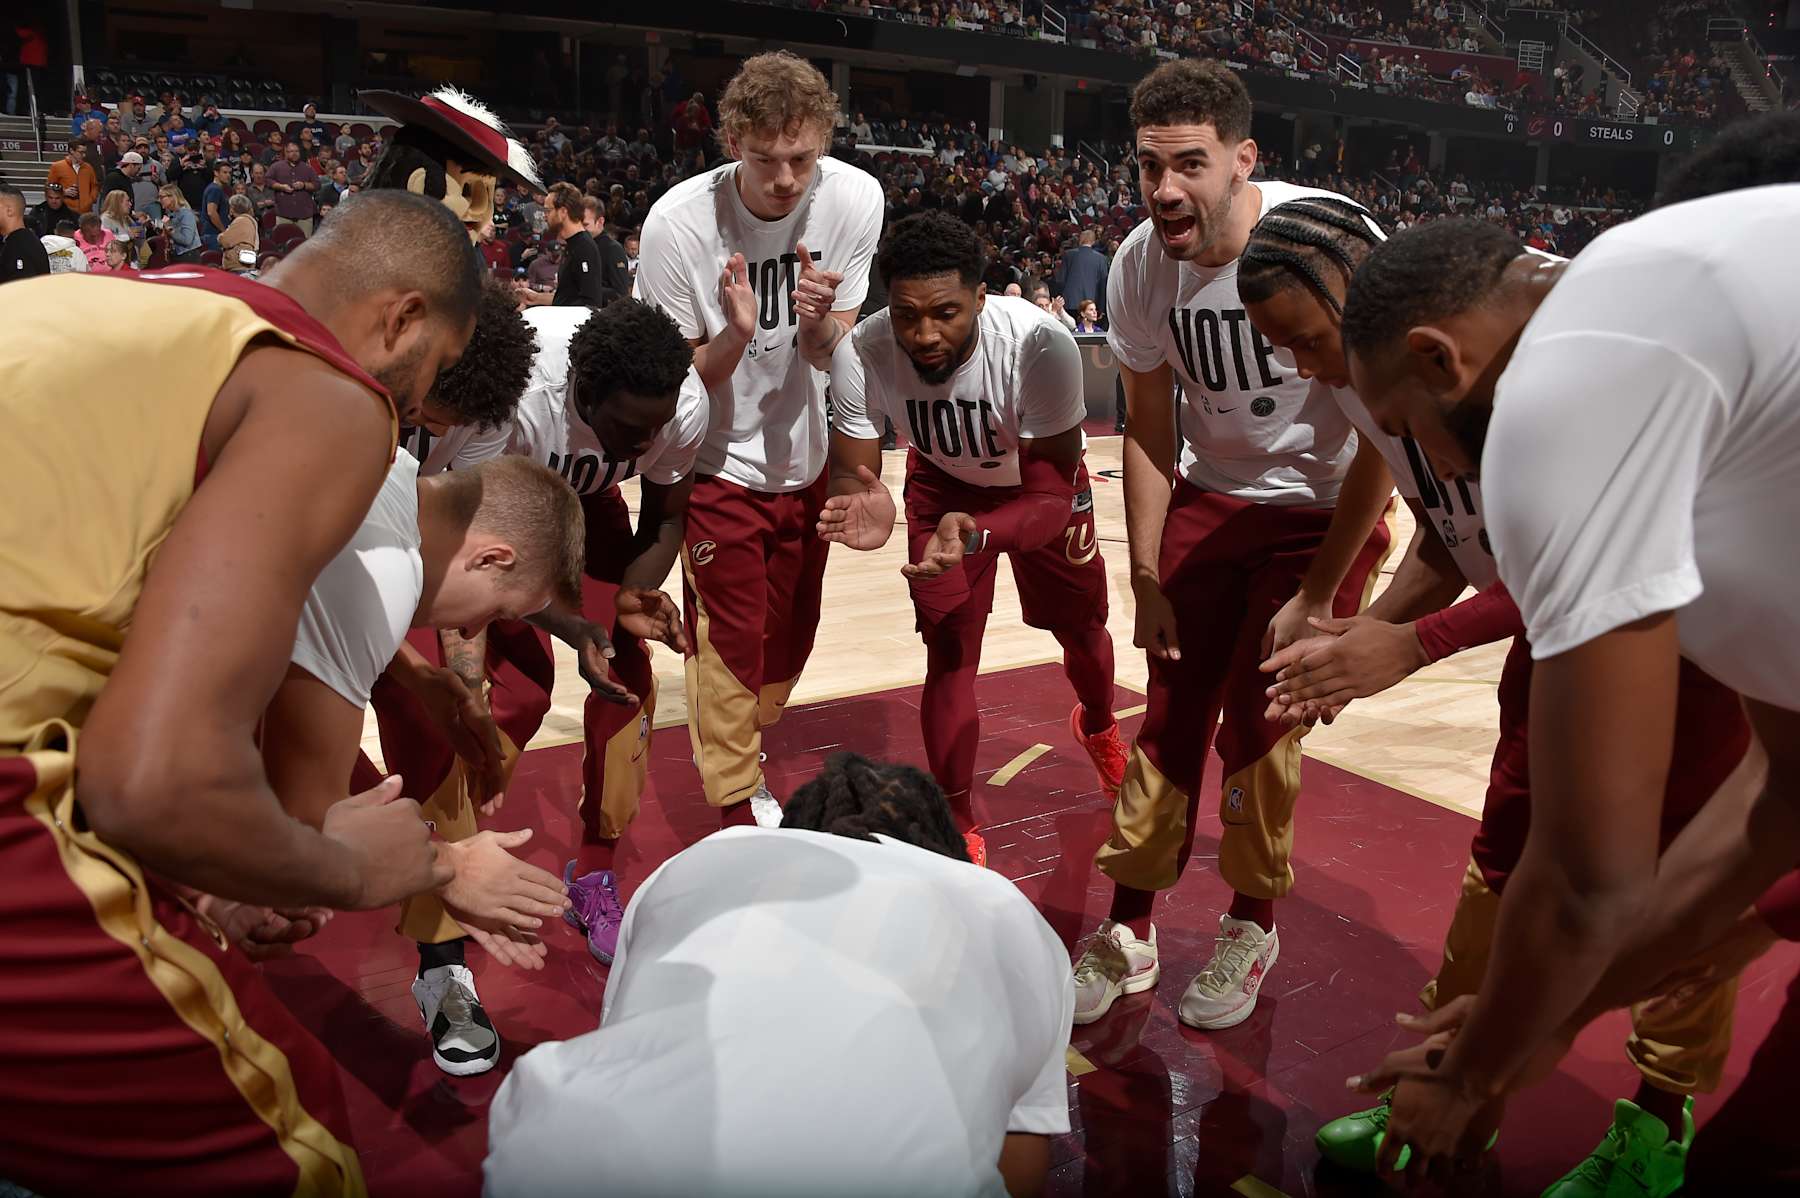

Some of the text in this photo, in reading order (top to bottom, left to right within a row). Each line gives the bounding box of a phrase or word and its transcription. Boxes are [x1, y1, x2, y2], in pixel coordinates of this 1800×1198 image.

[1507, 122, 1513, 132] 0
[1553, 121, 1674, 145] 0 STEALS 0
[2, 142, 20, 150] 106
[1169, 307, 1283, 392] VOTE
[906, 399, 1007, 458] VOTE
